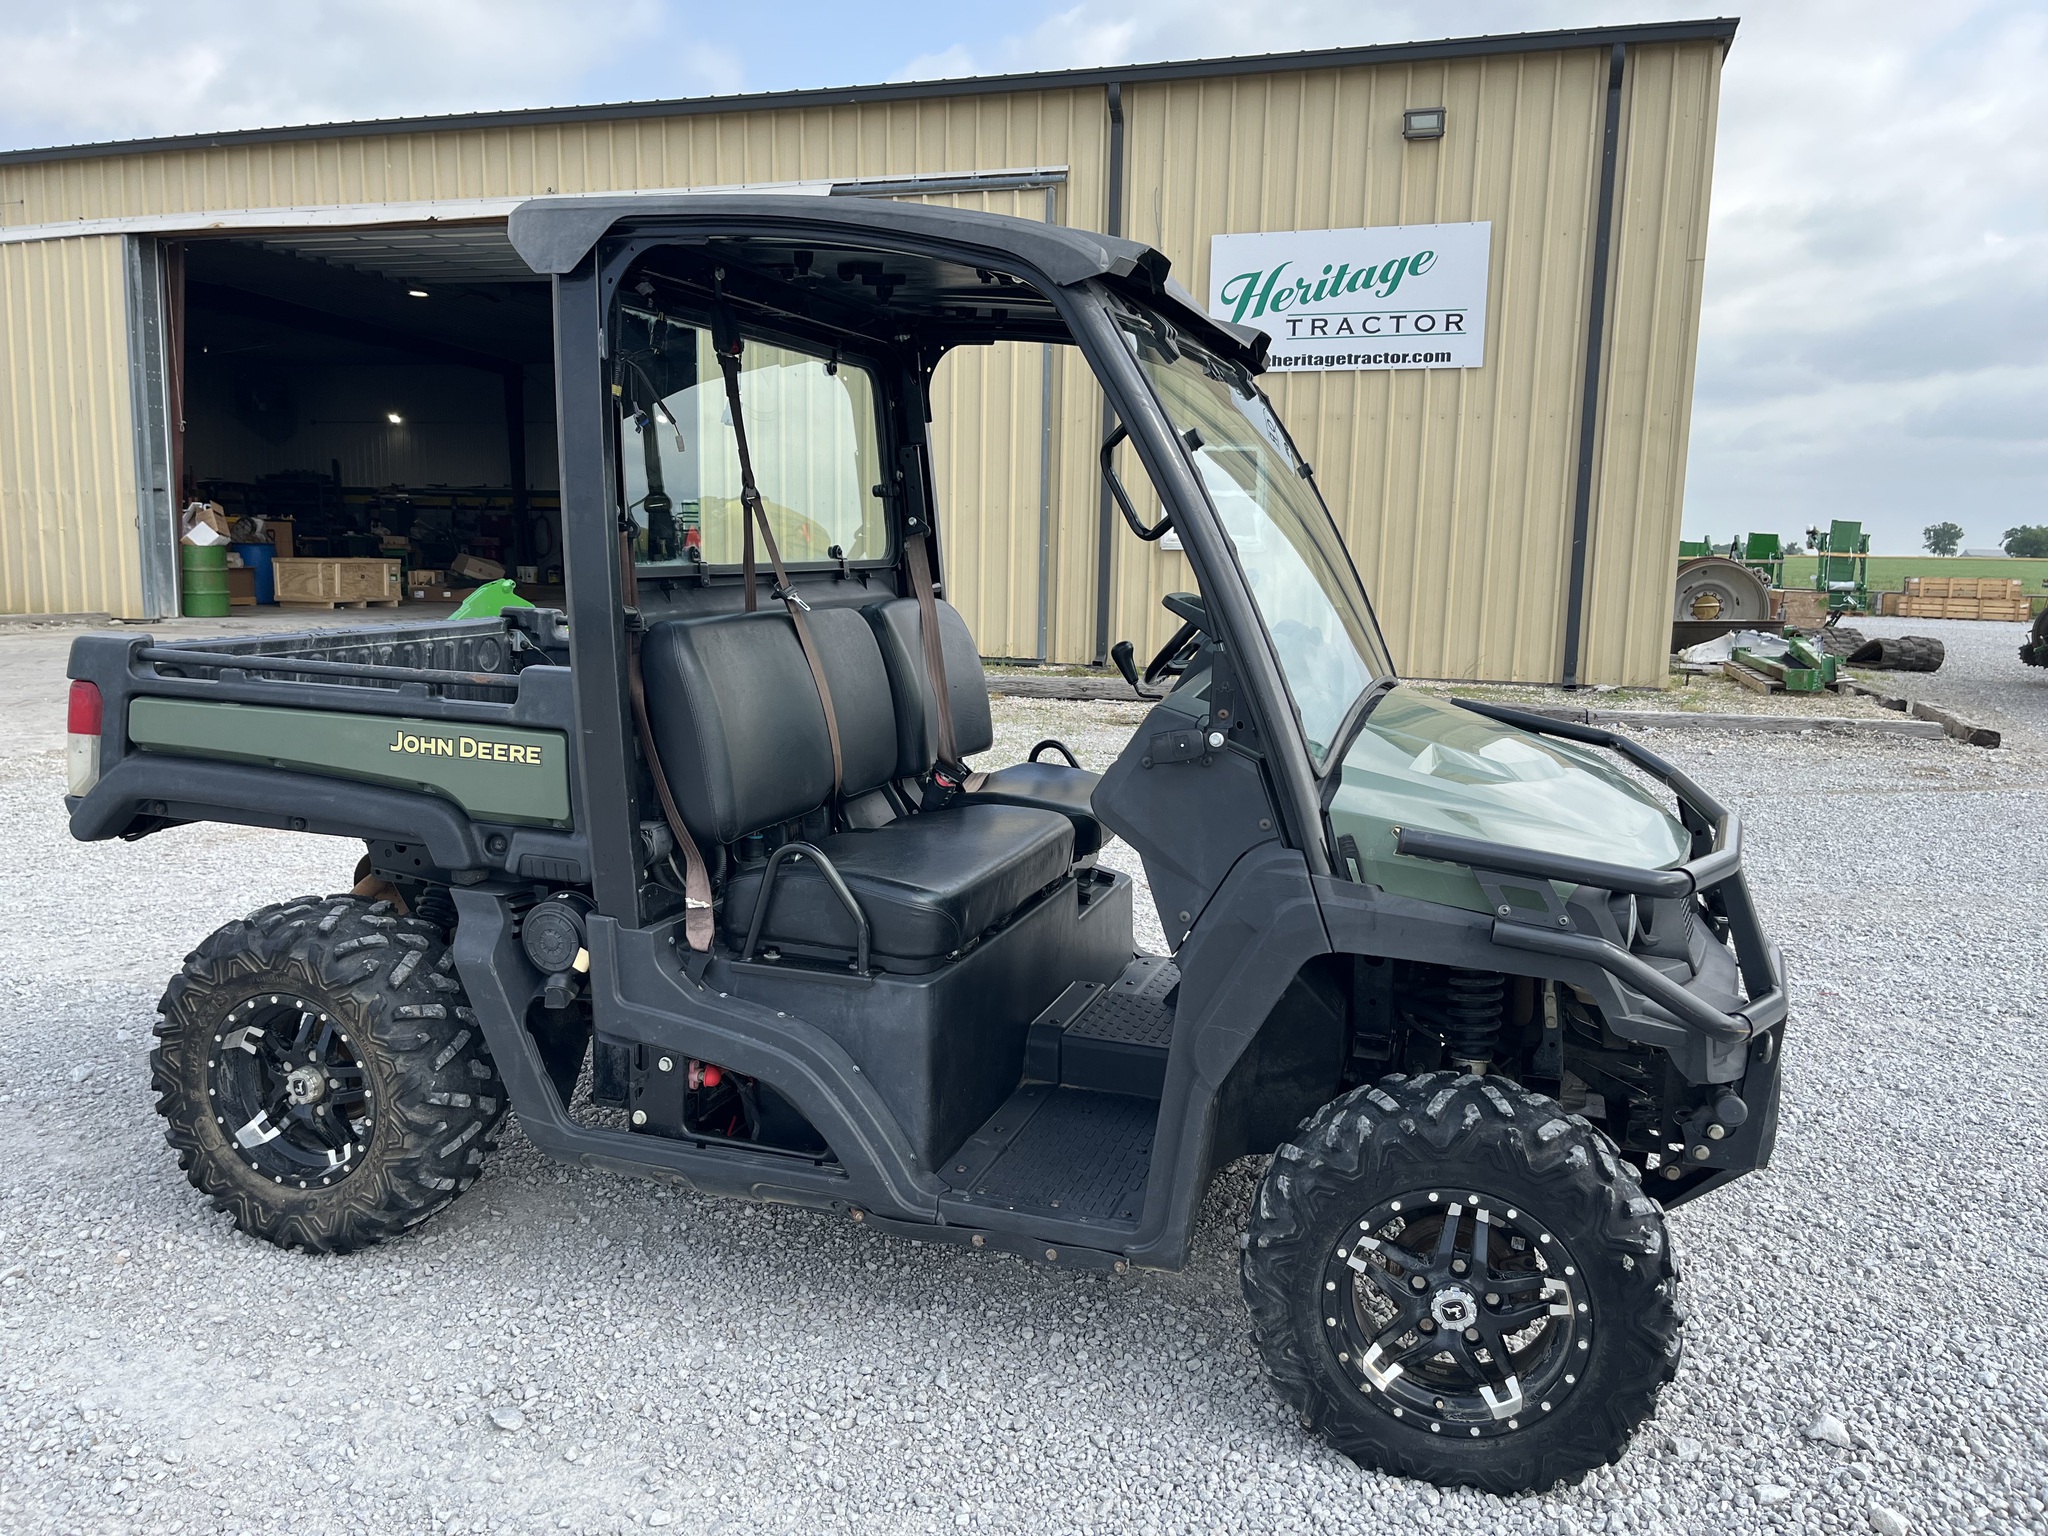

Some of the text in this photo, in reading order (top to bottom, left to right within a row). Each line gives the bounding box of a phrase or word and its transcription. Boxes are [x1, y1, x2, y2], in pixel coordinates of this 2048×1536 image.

[1221, 250, 1438, 324] Heritage
[1286, 313, 1464, 337] TRACTOR
[389, 730, 542, 765] JOHN DEERE
